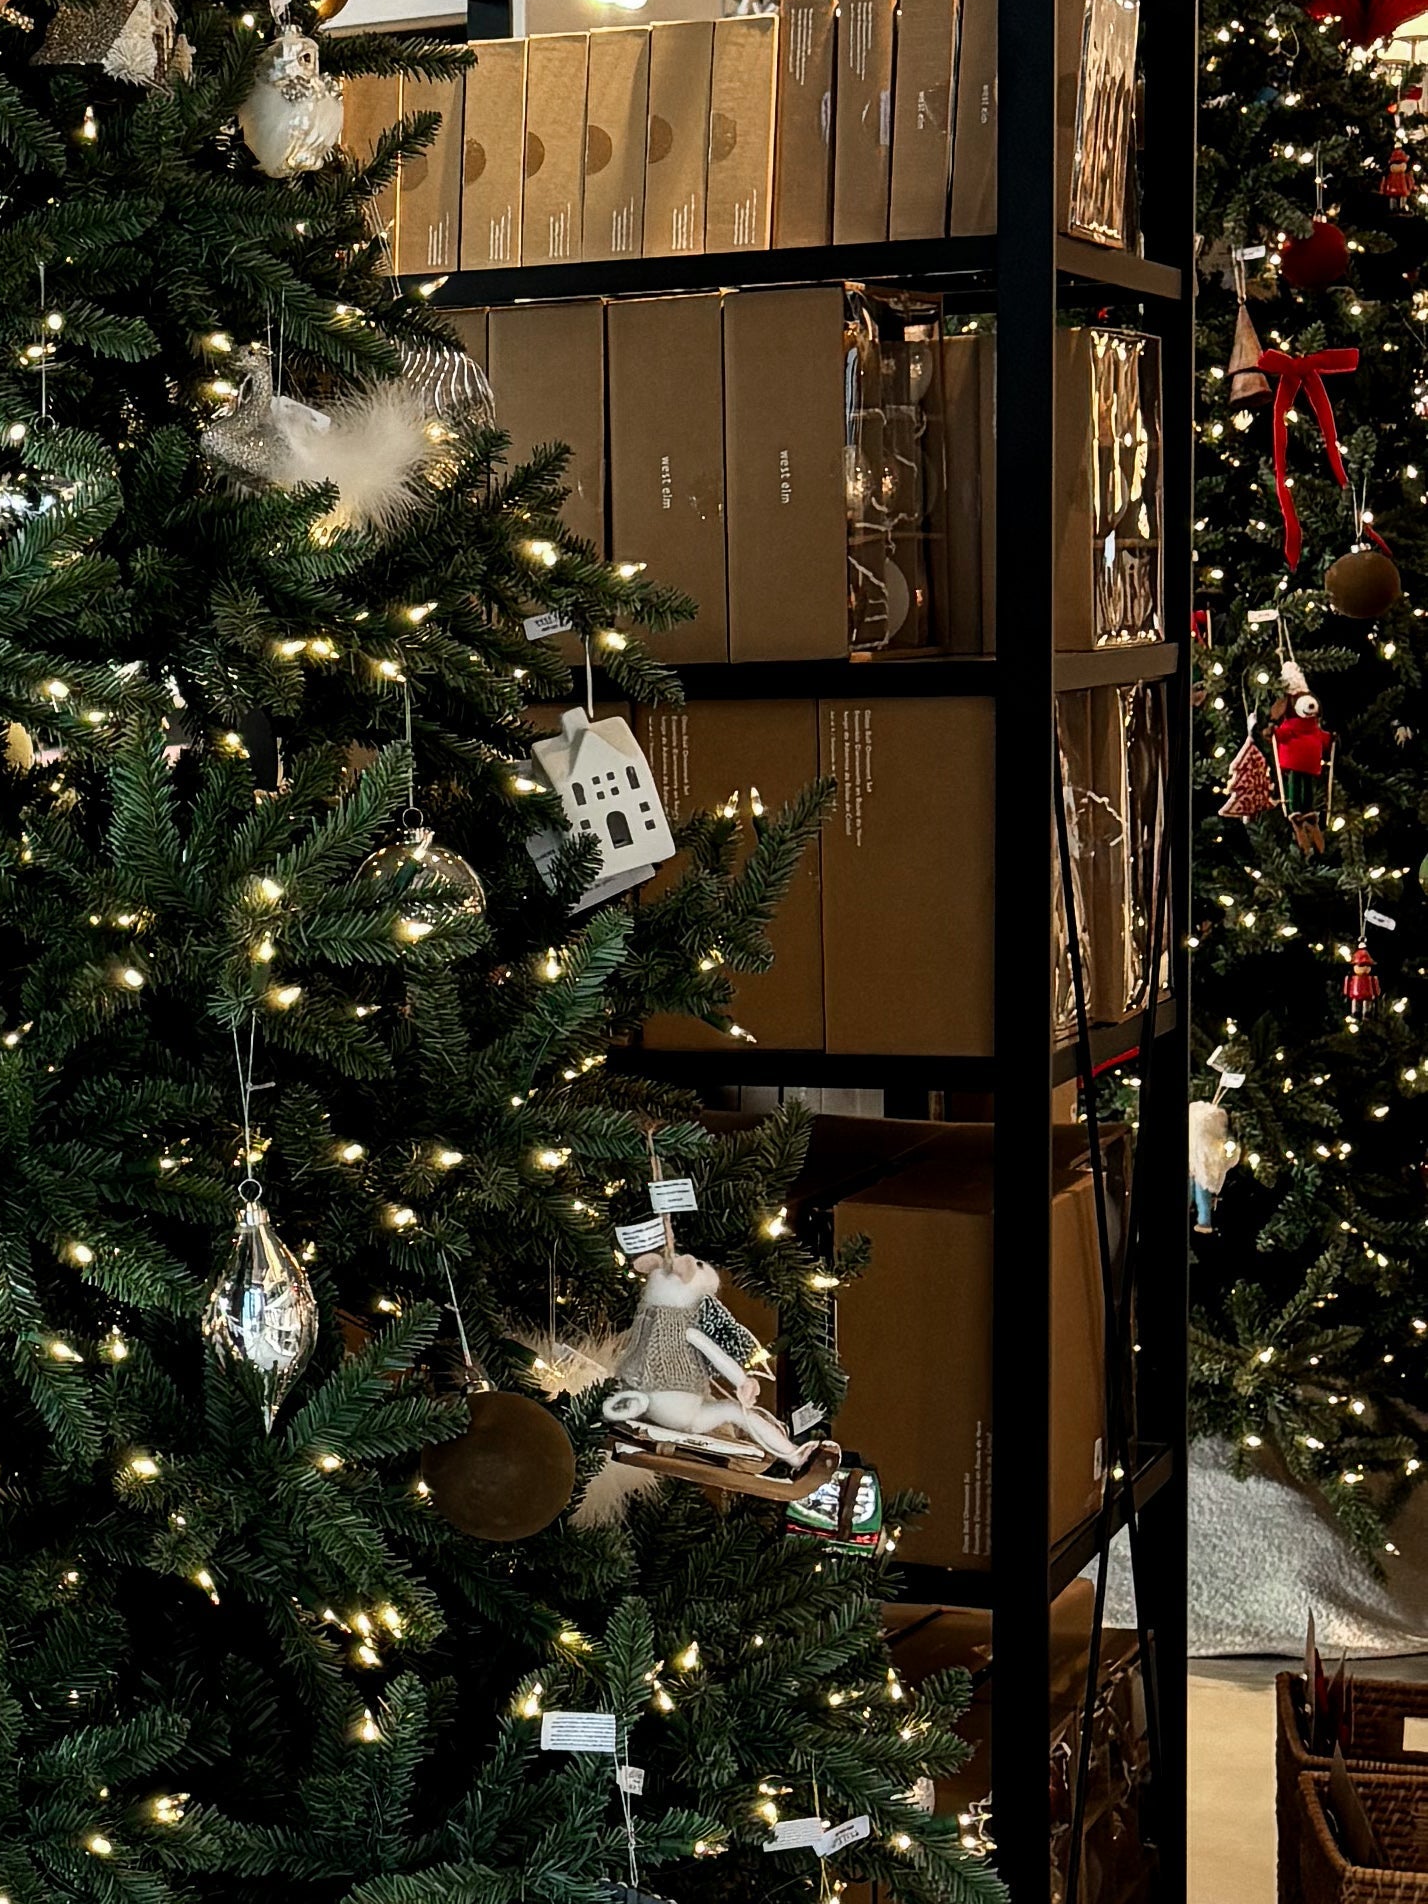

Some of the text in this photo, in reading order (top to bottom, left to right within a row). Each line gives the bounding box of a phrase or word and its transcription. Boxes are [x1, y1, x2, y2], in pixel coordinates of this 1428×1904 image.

[661, 455, 673, 509] west elm
[780, 449, 792, 504] west elm
